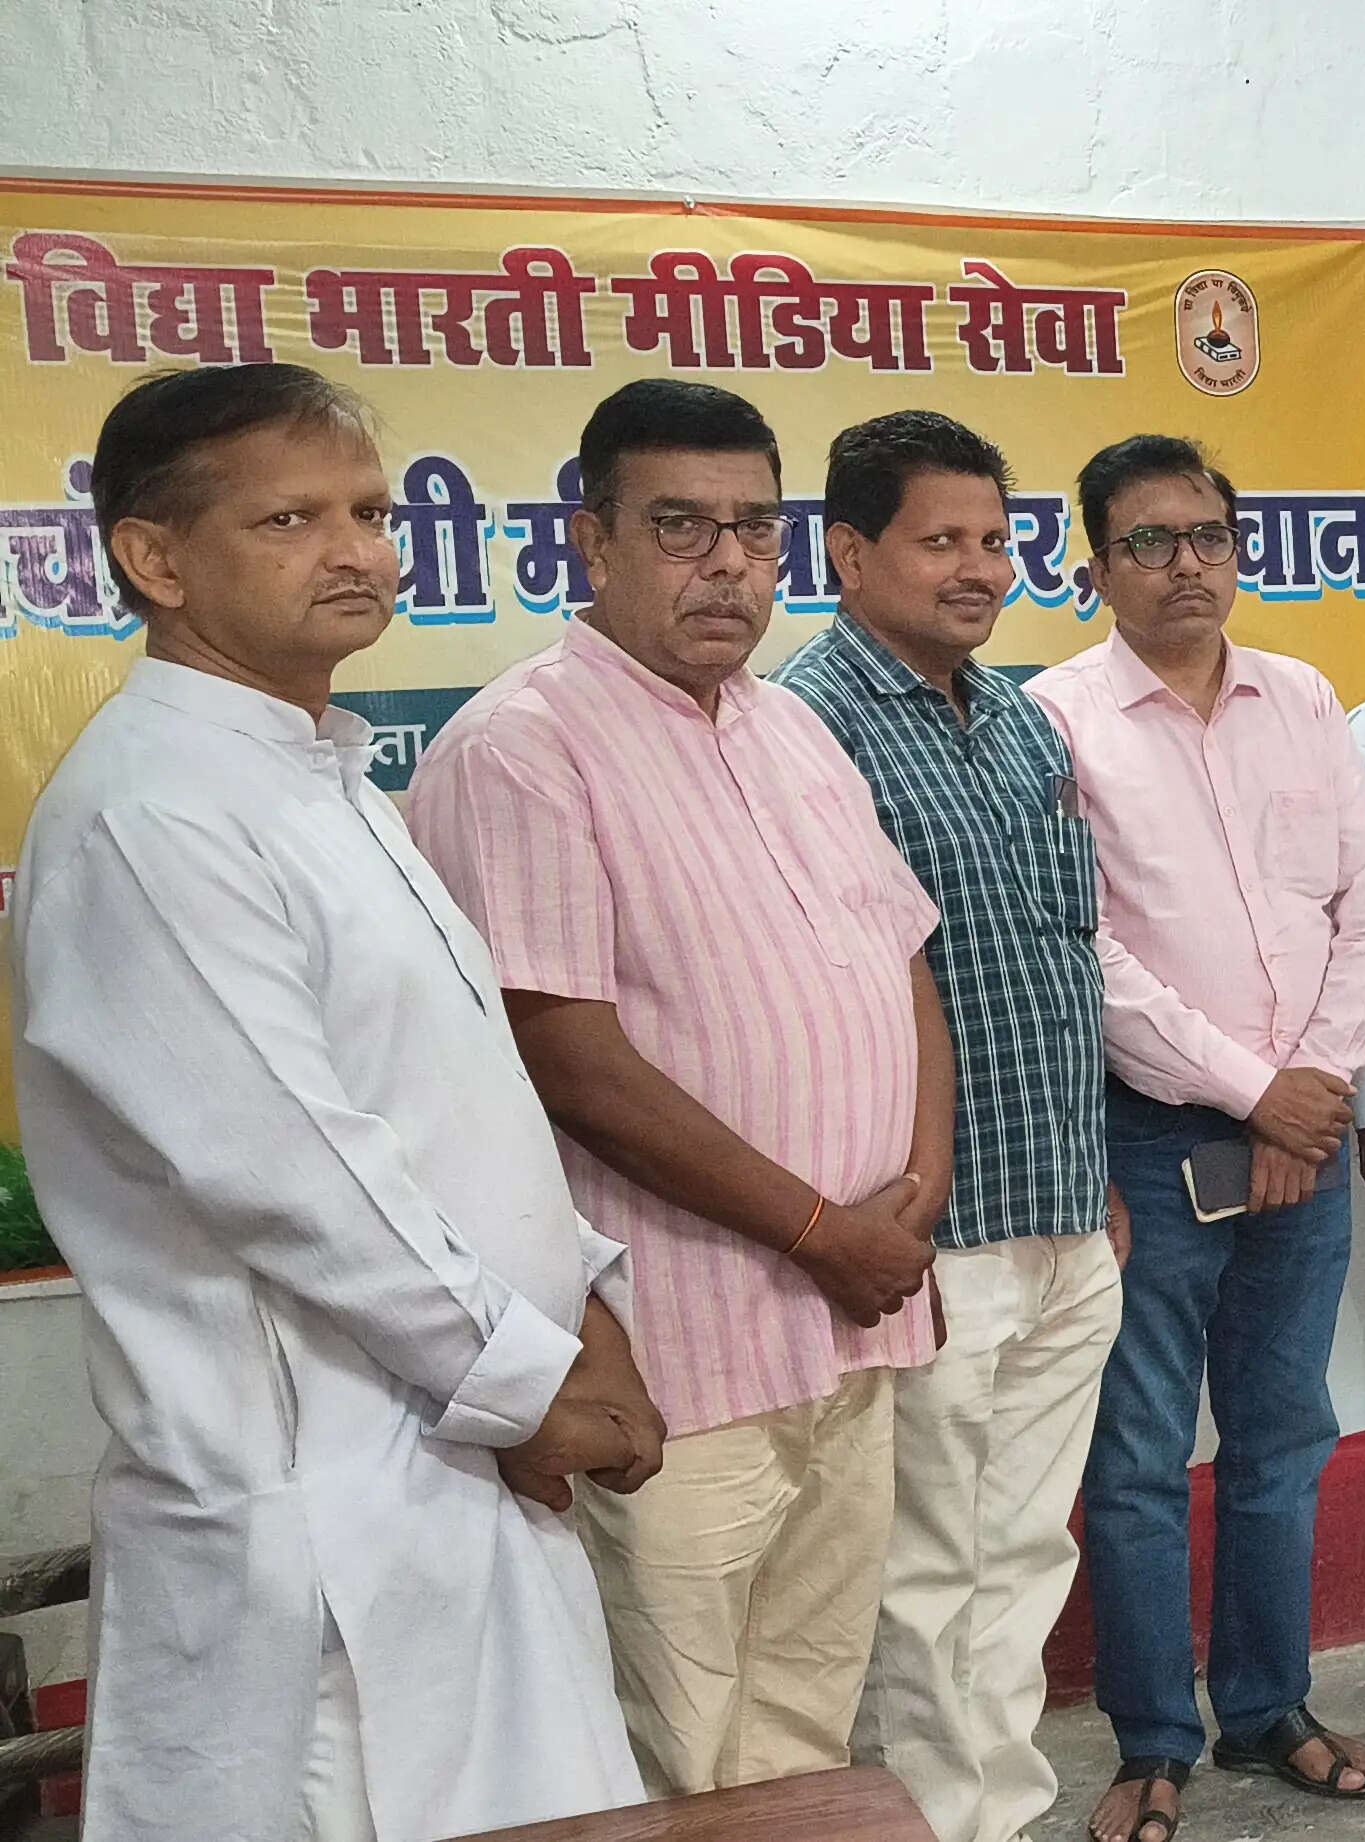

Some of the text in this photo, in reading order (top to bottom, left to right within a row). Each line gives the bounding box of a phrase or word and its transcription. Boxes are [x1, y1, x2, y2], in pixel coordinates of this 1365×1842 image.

[6, 233, 1127, 374] विद्या भारती मीडिया सेवा
